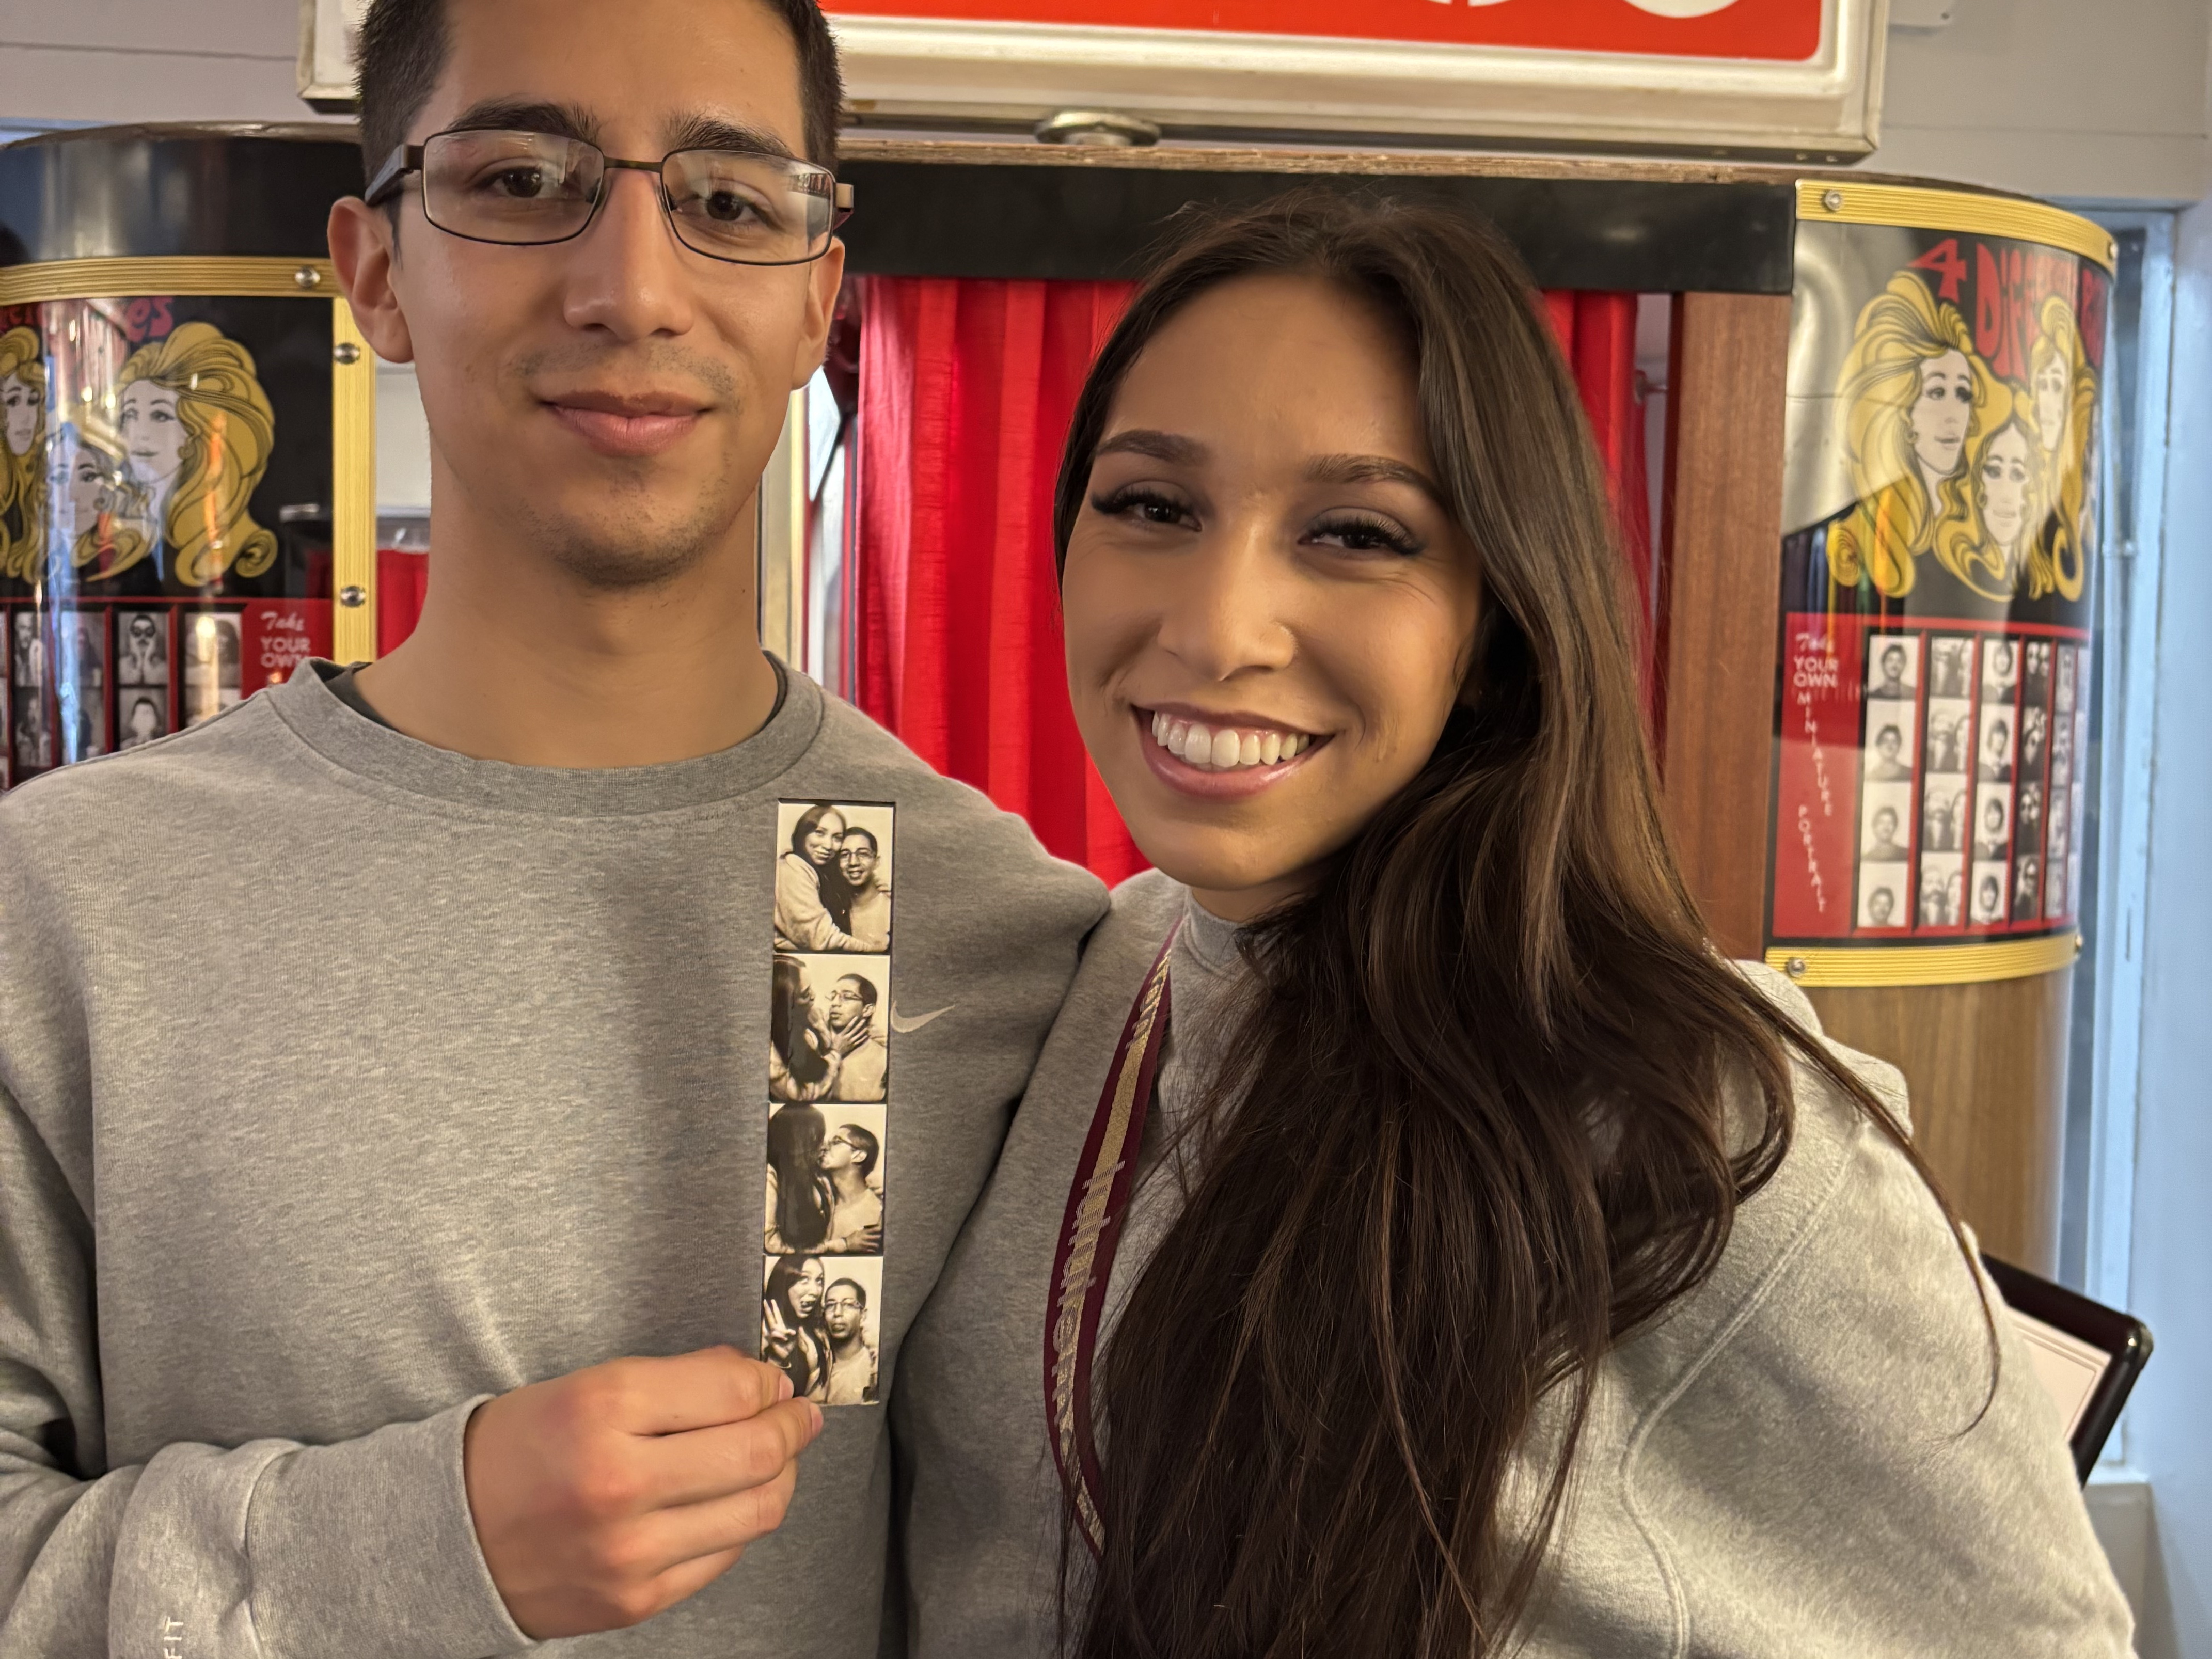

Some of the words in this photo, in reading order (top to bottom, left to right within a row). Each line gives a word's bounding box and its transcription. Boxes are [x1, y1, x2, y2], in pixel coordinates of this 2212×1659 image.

[1905, 238, 1968, 303] 4
[260, 636, 311, 653] YOUR
[1793, 655, 1839, 672] YOUR
[1793, 671, 1838, 688] OWN
